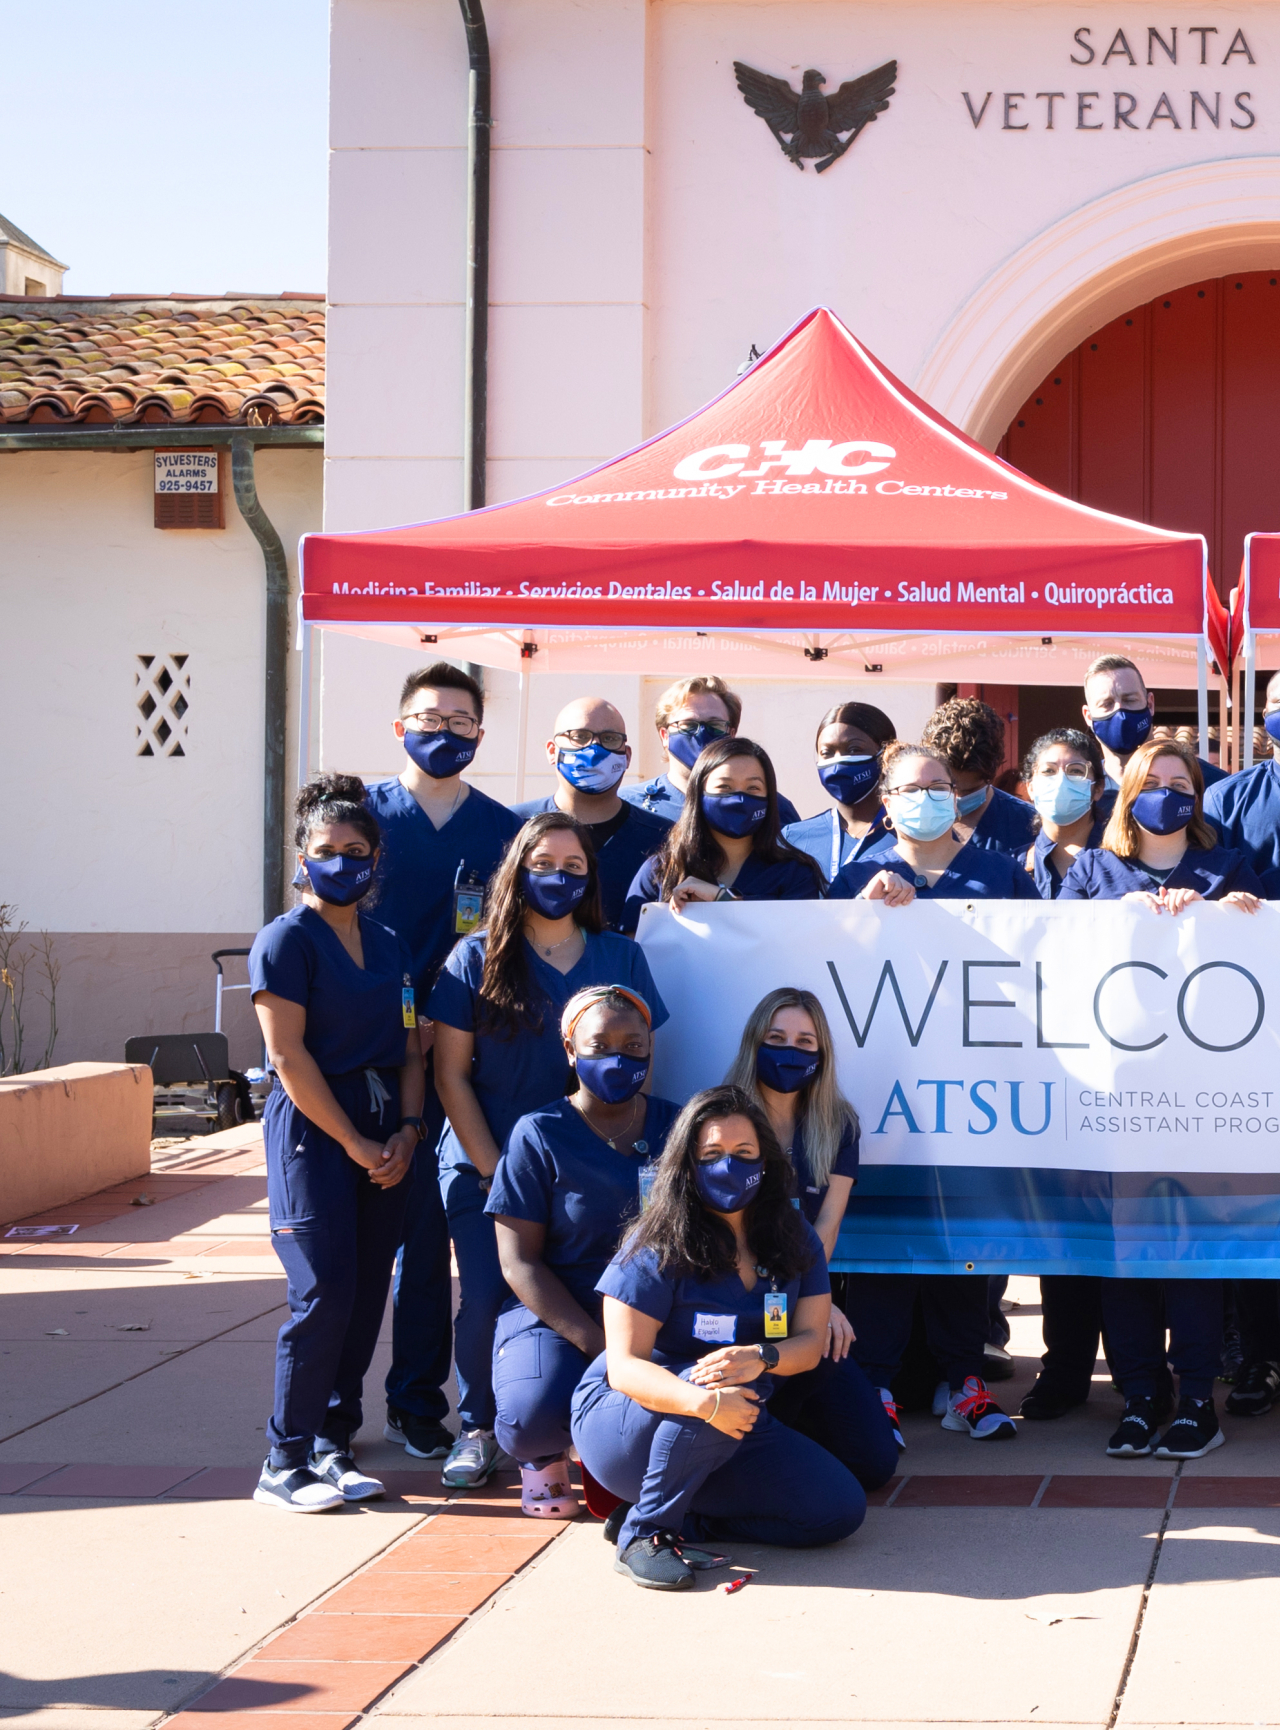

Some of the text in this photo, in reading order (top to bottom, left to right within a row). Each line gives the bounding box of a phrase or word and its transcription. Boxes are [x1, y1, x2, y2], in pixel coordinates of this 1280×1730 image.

[1069, 26, 1256, 66] SANTA
[961, 91, 1256, 130] VETERANS
[155, 454, 217, 469] SYLVESTERS
[672, 439, 897, 482] CHC
[165, 468, 207, 478] ALARMS
[159, 480, 213, 492] 925-9457
[546, 478, 1009, 508] Community Health Centers
[518, 581, 602, 599] Servicios
[608, 580, 692, 600] Dentales
[710, 579, 763, 601] Salud
[769, 580, 795, 602] de
[799, 580, 817, 602] la
[822, 580, 879, 607] Mujer
[897, 580, 951, 603] Salud
[957, 581, 1025, 604] Mental
[1044, 581, 1174, 609] Quiropráctica
[1136, 718, 1149, 730] ATSU
[456, 750, 474, 761] ATSU
[853, 769, 871, 782] ATSU
[1178, 805, 1194, 815] ATSU
[1079, 1090, 1186, 1108] CENTRAL
[1195, 1090, 1275, 1108] COAST
[870, 1078, 1057, 1136] ATSU
[1080, 1115, 1205, 1133] ASSISTANT
[745, 1172, 761, 1187] ATSU
[700, 1318, 719, 1326] Hablo
